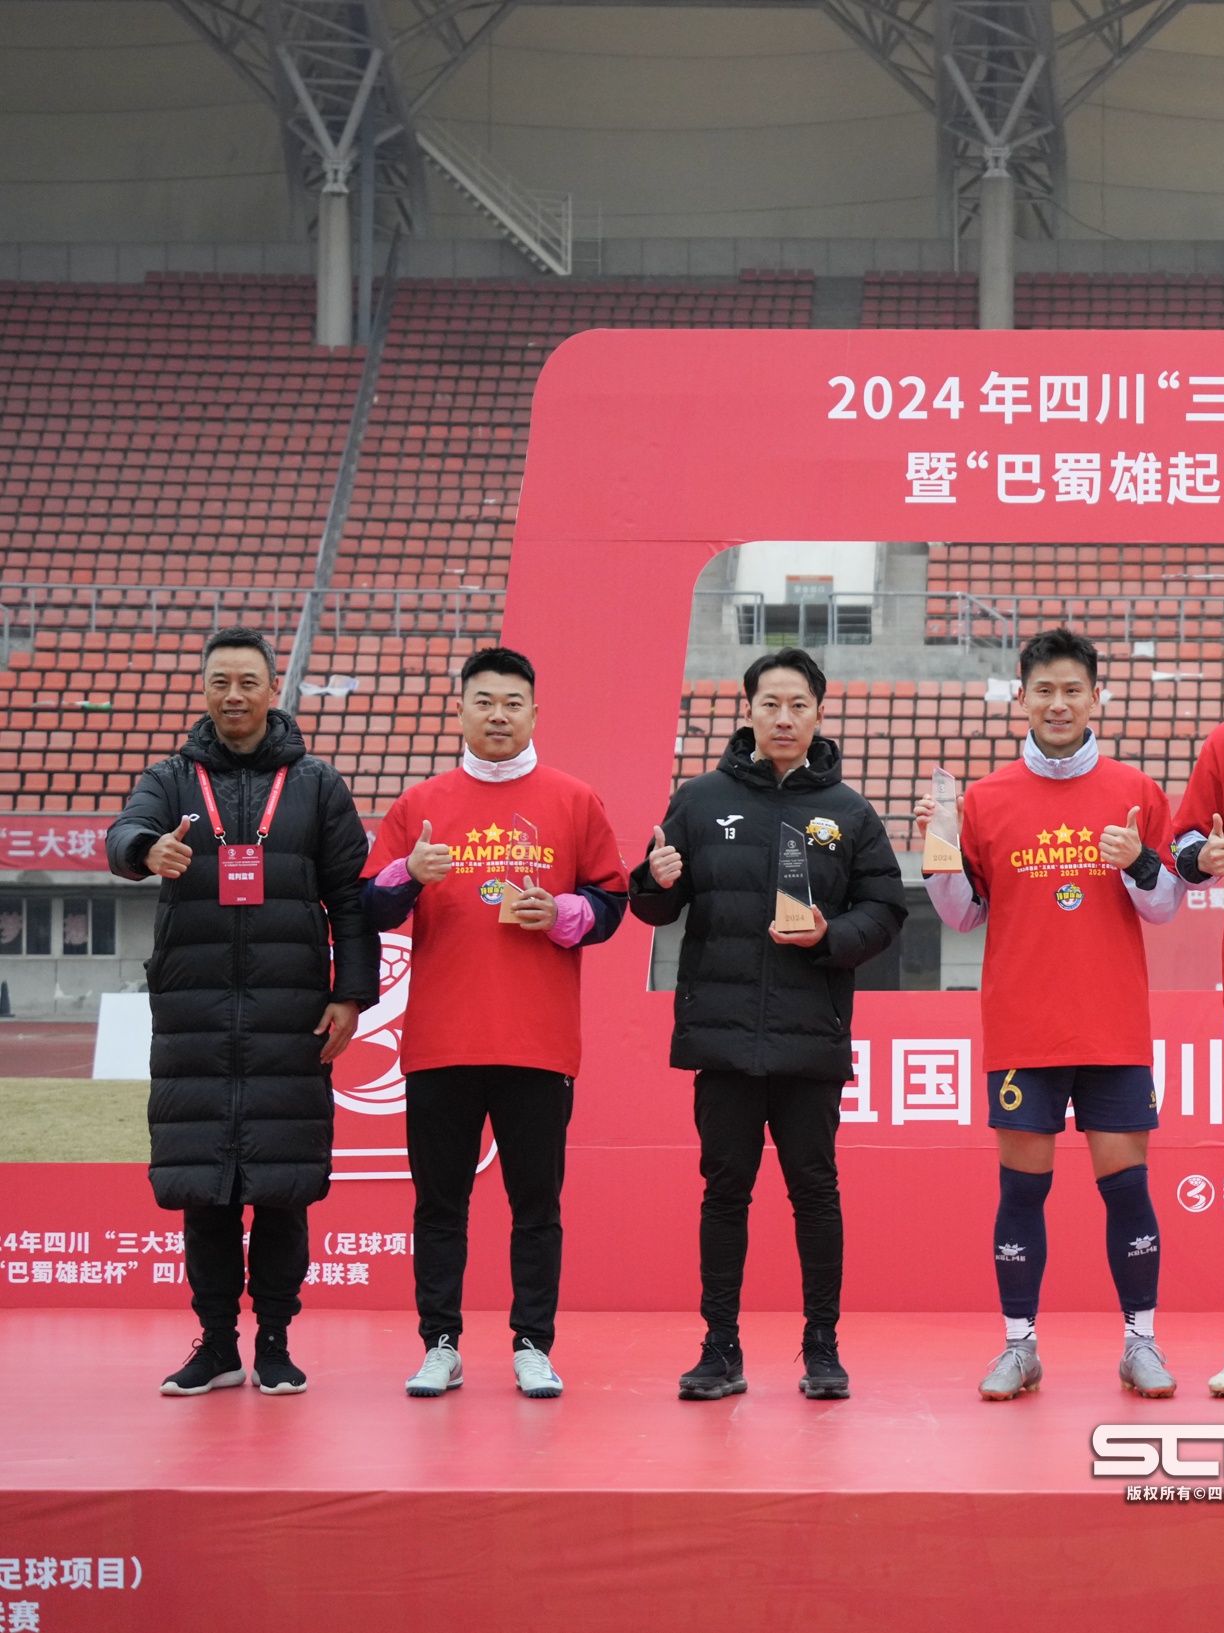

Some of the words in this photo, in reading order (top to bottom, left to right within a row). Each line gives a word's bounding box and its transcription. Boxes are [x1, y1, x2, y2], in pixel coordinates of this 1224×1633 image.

[724, 827, 736, 840] 13
[829, 842, 836, 851] G
[932, 854, 953, 862] 2024
[1010, 845, 1105, 867] CHAMPIO
[515, 866, 534, 874] 2024
[1030, 870, 1048, 878] 2022
[1089, 868, 1107, 876] 2024
[785, 914, 805, 922] 2024
[1127, 1245, 1158, 1258] KELME
[996, 1254, 1026, 1262] KELME
